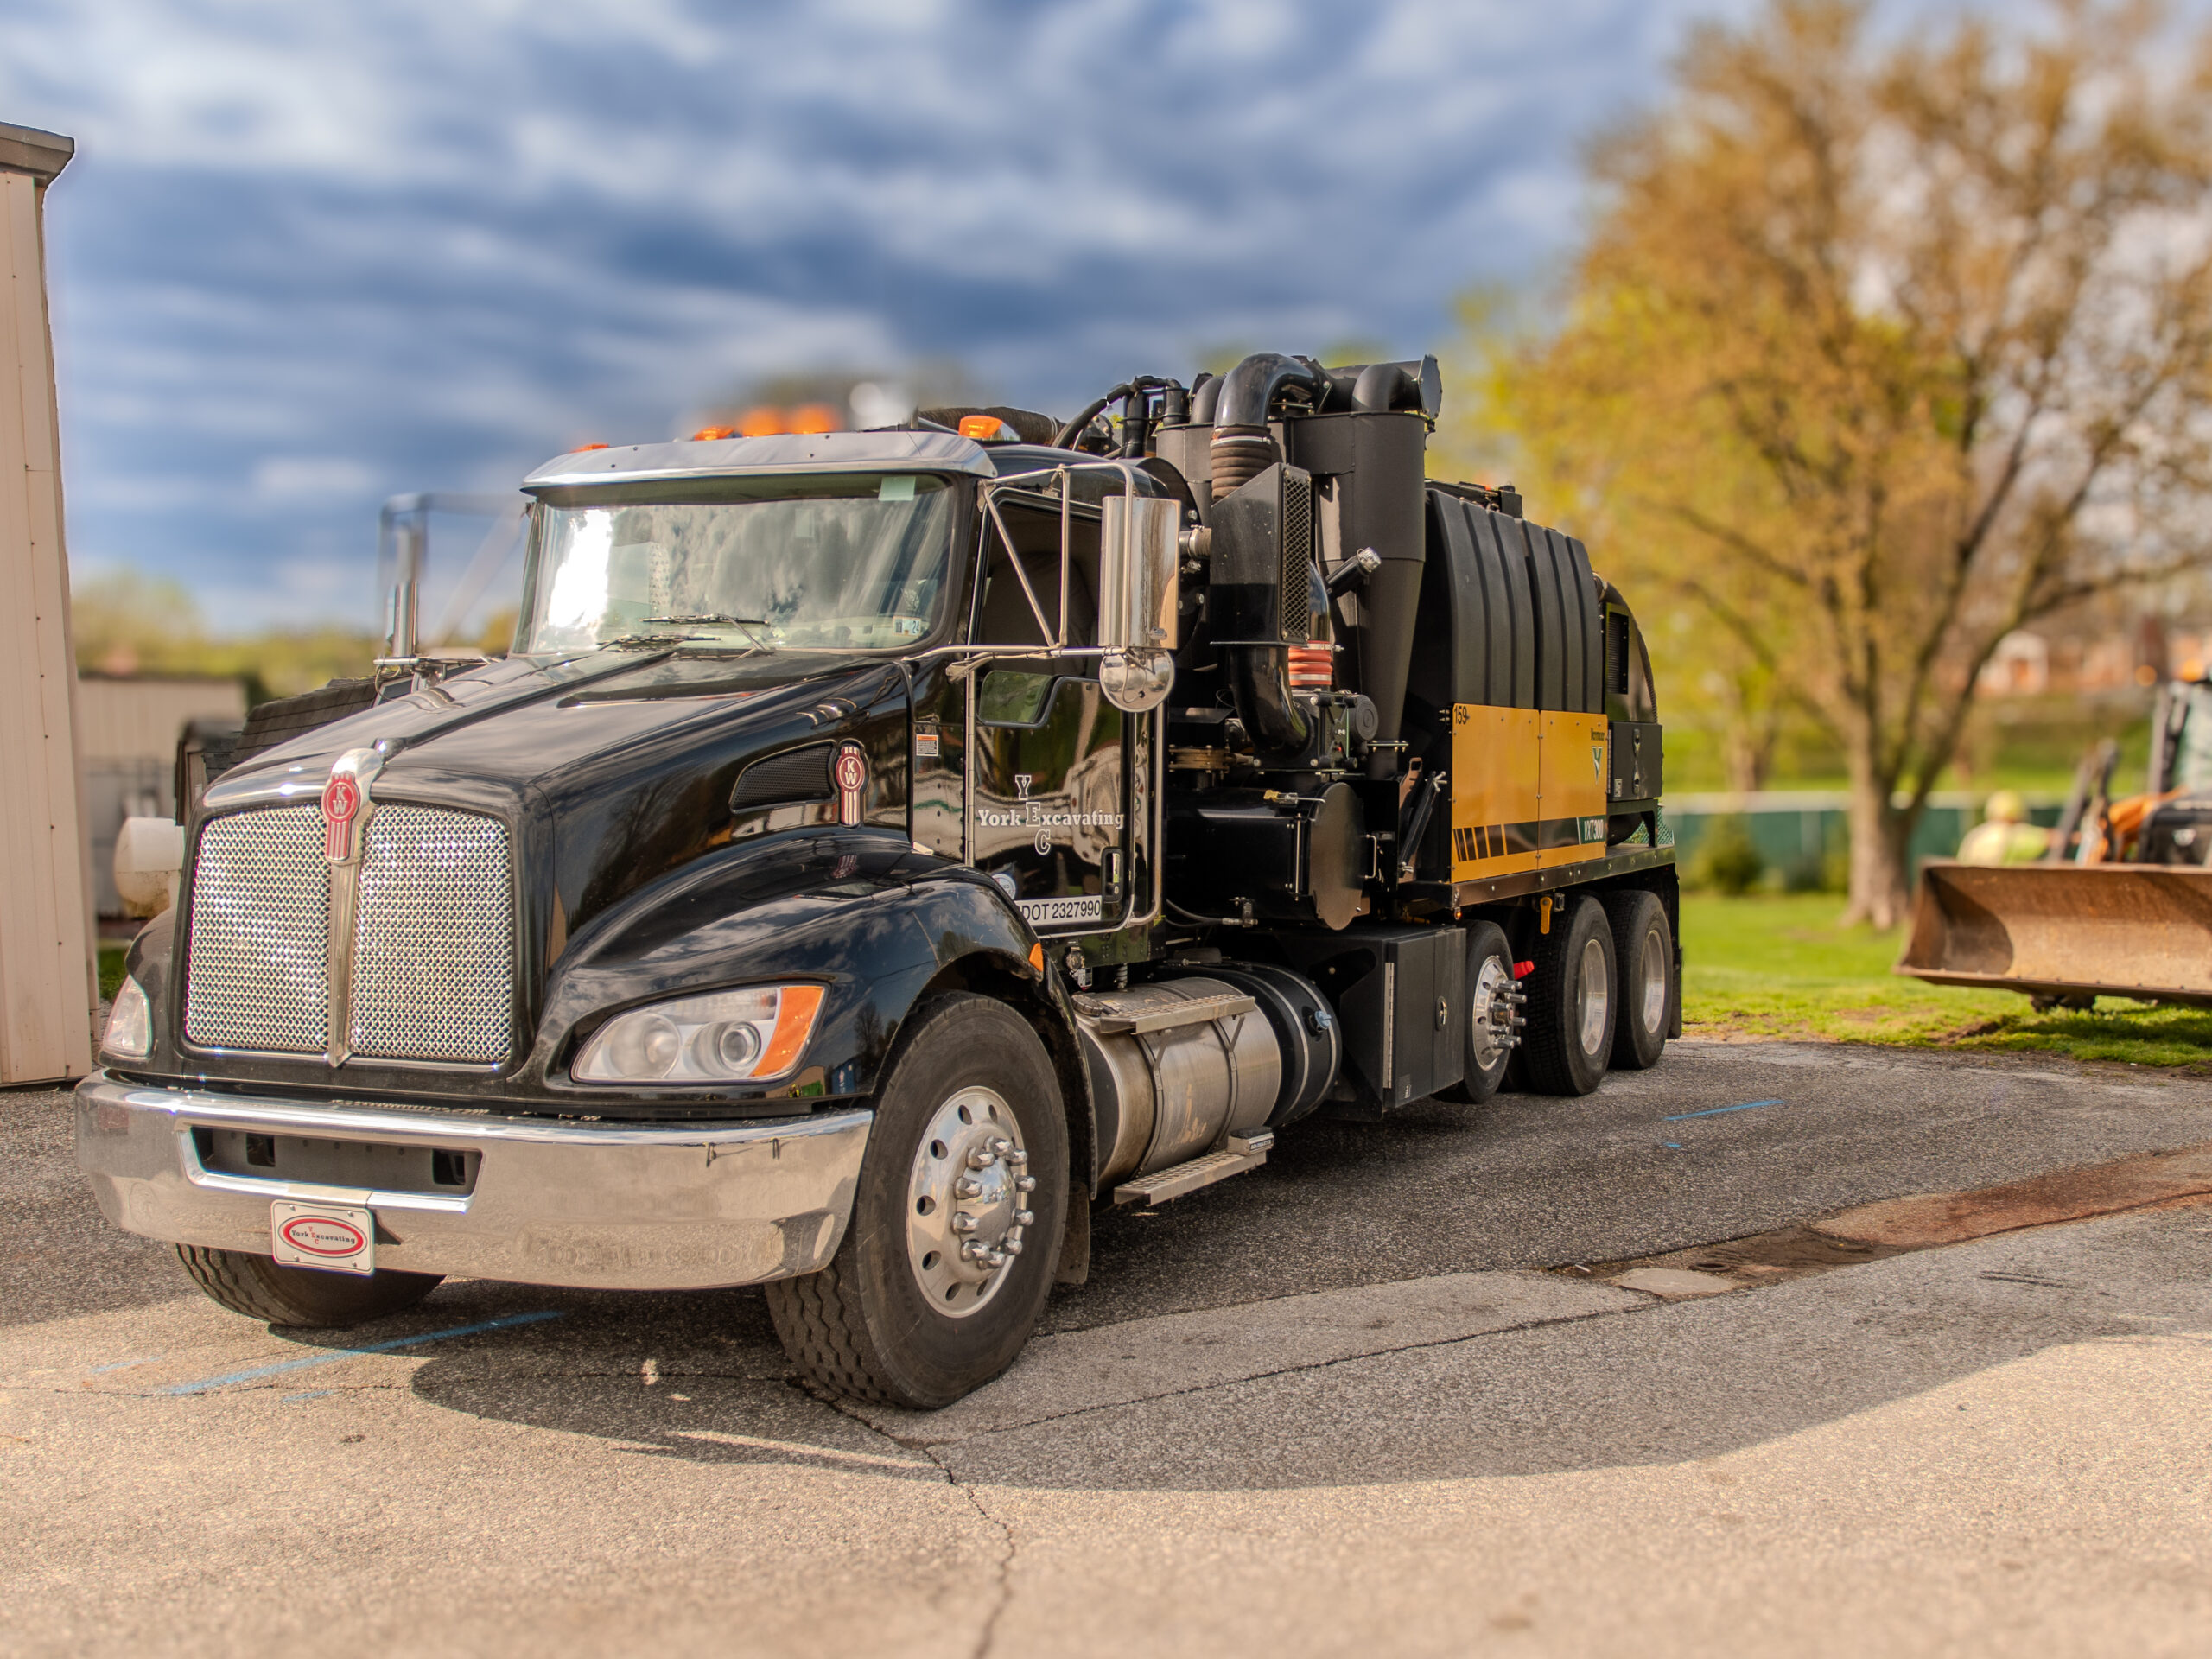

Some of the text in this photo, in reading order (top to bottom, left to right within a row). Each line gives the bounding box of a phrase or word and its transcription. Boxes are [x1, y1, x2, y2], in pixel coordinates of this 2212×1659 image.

[1454, 705, 1467, 725] 159
[847, 760, 855, 772] K
[844, 772, 857, 785] W
[336, 786, 346, 800] K
[1015, 775, 1032, 800] Y
[332, 800, 348, 815] W
[978, 802, 1124, 830] York Excavating
[1034, 830, 1051, 855] C
[1018, 900, 1101, 920] DOT 2327990
[311, 1232, 355, 1244] Excavating
